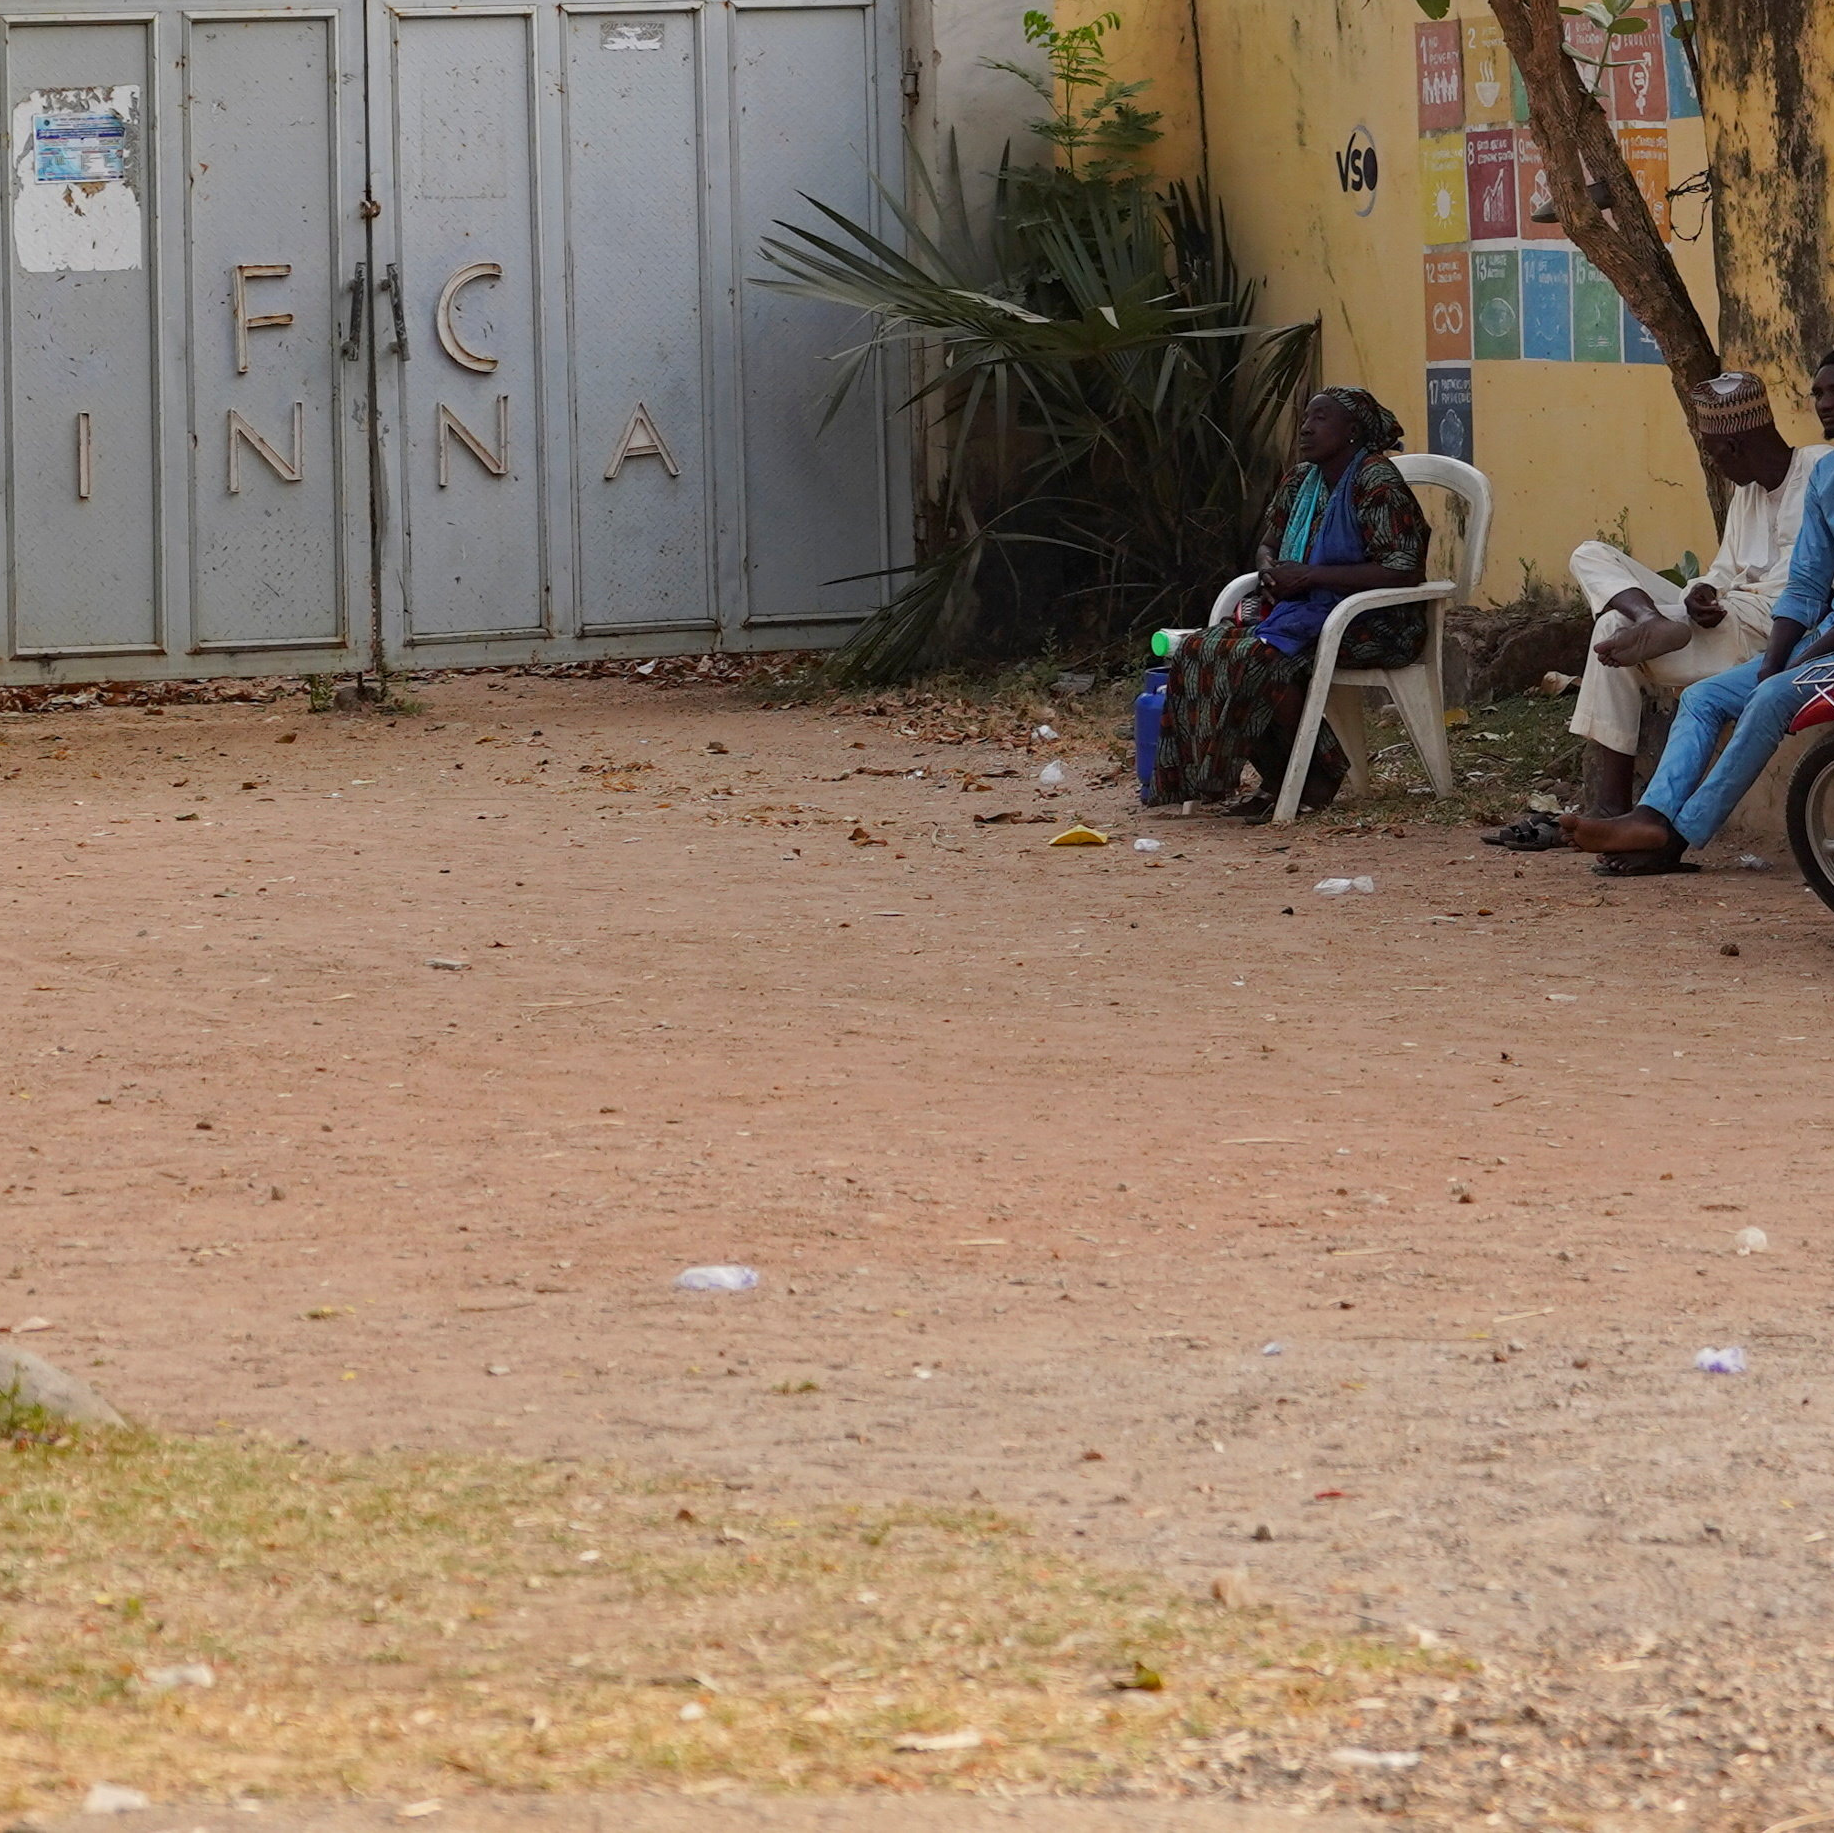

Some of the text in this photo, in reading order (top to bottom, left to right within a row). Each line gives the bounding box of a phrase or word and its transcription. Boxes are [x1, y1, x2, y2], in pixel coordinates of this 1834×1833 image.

[1467, 142, 1475, 165] 8
[1476, 255, 1487, 281] 13
[1429, 380, 1438, 405] 17
